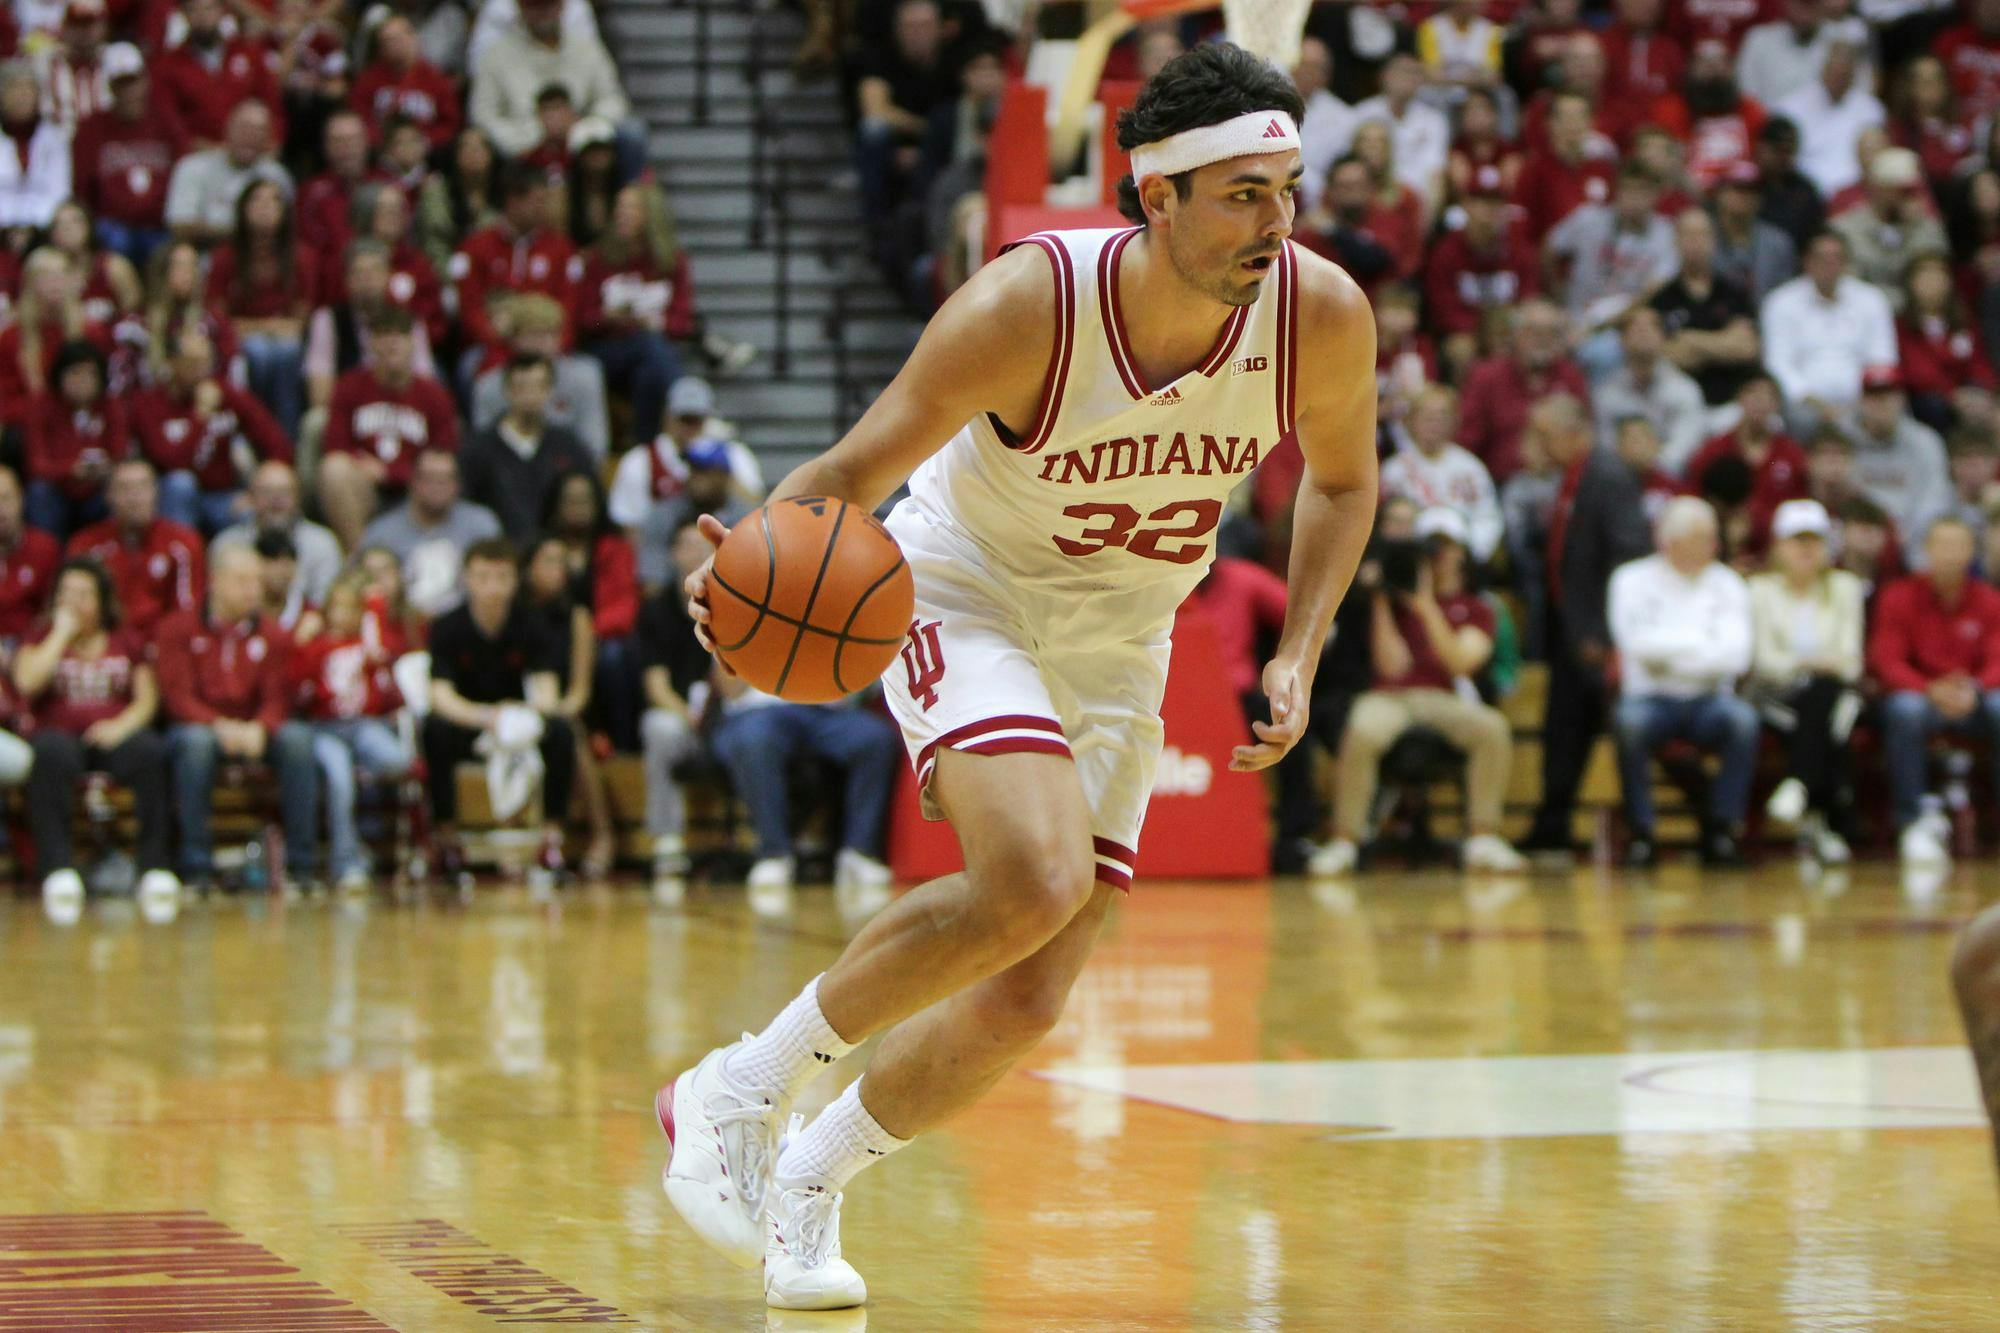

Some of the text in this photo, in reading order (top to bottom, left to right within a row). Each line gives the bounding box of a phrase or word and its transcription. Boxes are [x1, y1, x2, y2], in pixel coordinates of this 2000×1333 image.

[1037, 432, 1259, 484] INDIANA
[1052, 499, 1222, 564] 32
[379, 1253, 640, 1323] ASSEMBLY
